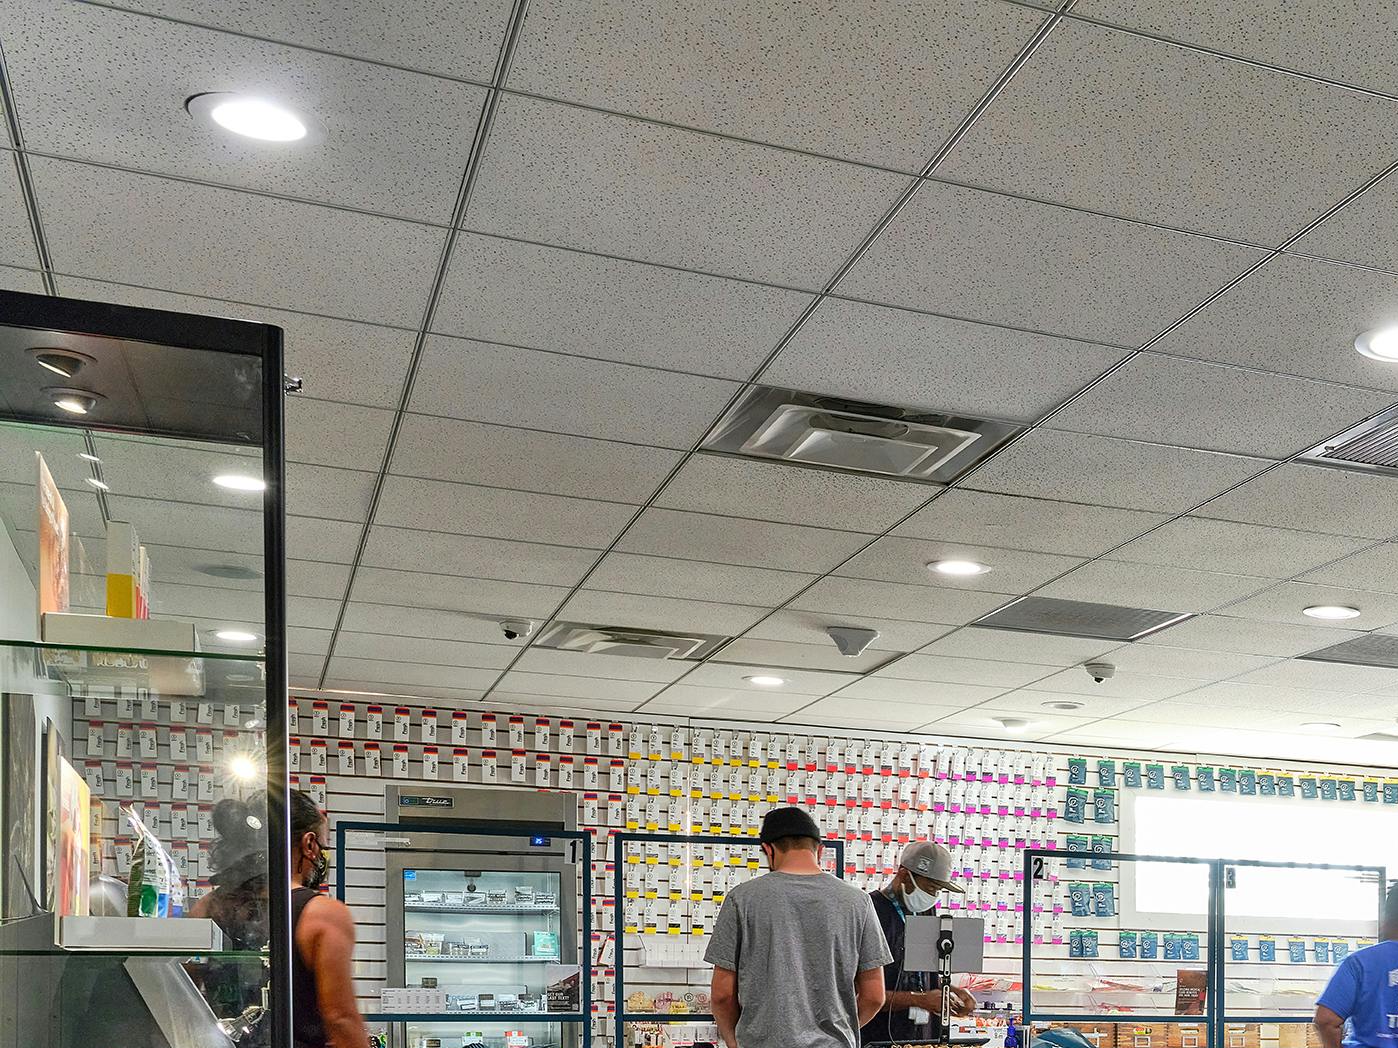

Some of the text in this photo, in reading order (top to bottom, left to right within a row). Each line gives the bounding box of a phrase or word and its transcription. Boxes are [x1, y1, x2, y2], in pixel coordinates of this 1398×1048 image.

[570, 840, 576, 863] 1
[1033, 858, 1043, 878] 2
[1228, 871, 1234, 886] 3
